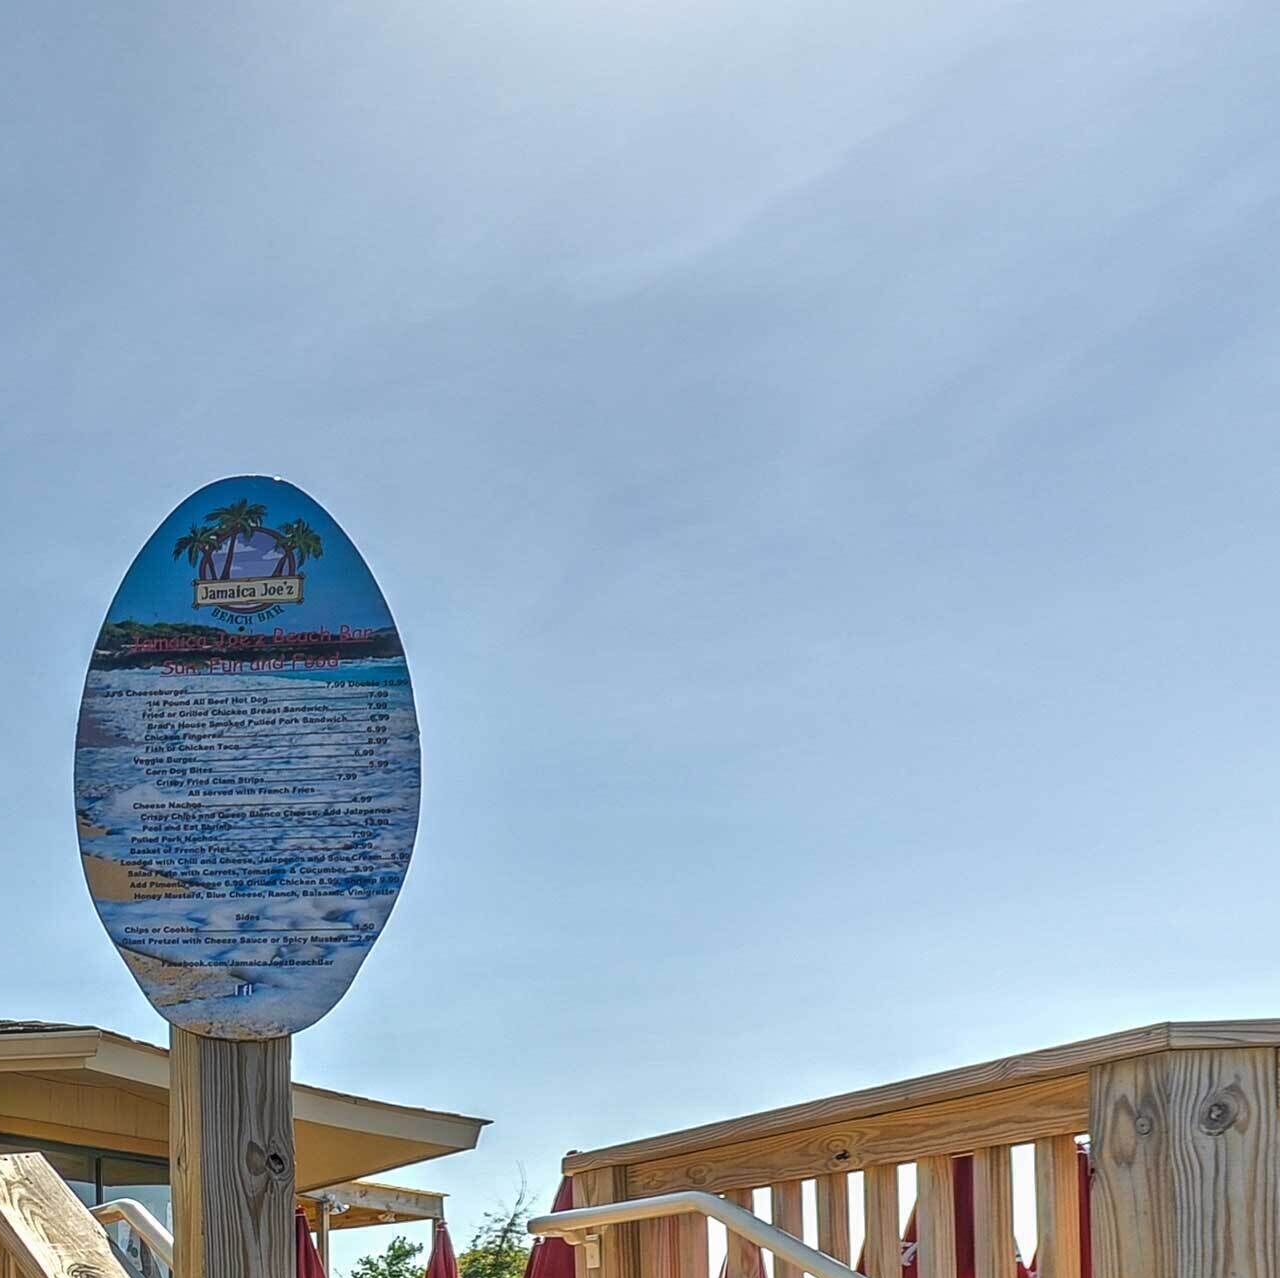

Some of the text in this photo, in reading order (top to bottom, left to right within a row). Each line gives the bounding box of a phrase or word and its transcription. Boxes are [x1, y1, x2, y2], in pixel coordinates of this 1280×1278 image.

[201, 582, 294, 600] Jamaica Joe'z
[211, 605, 285, 625] BEACH BAR
[130, 632, 207, 651] Jamaica
[273, 625, 331, 644] Beach
[340, 624, 373, 641] Bar
[209, 657, 244, 674] Fun
[249, 655, 283, 671] and
[292, 653, 340, 669] Food
